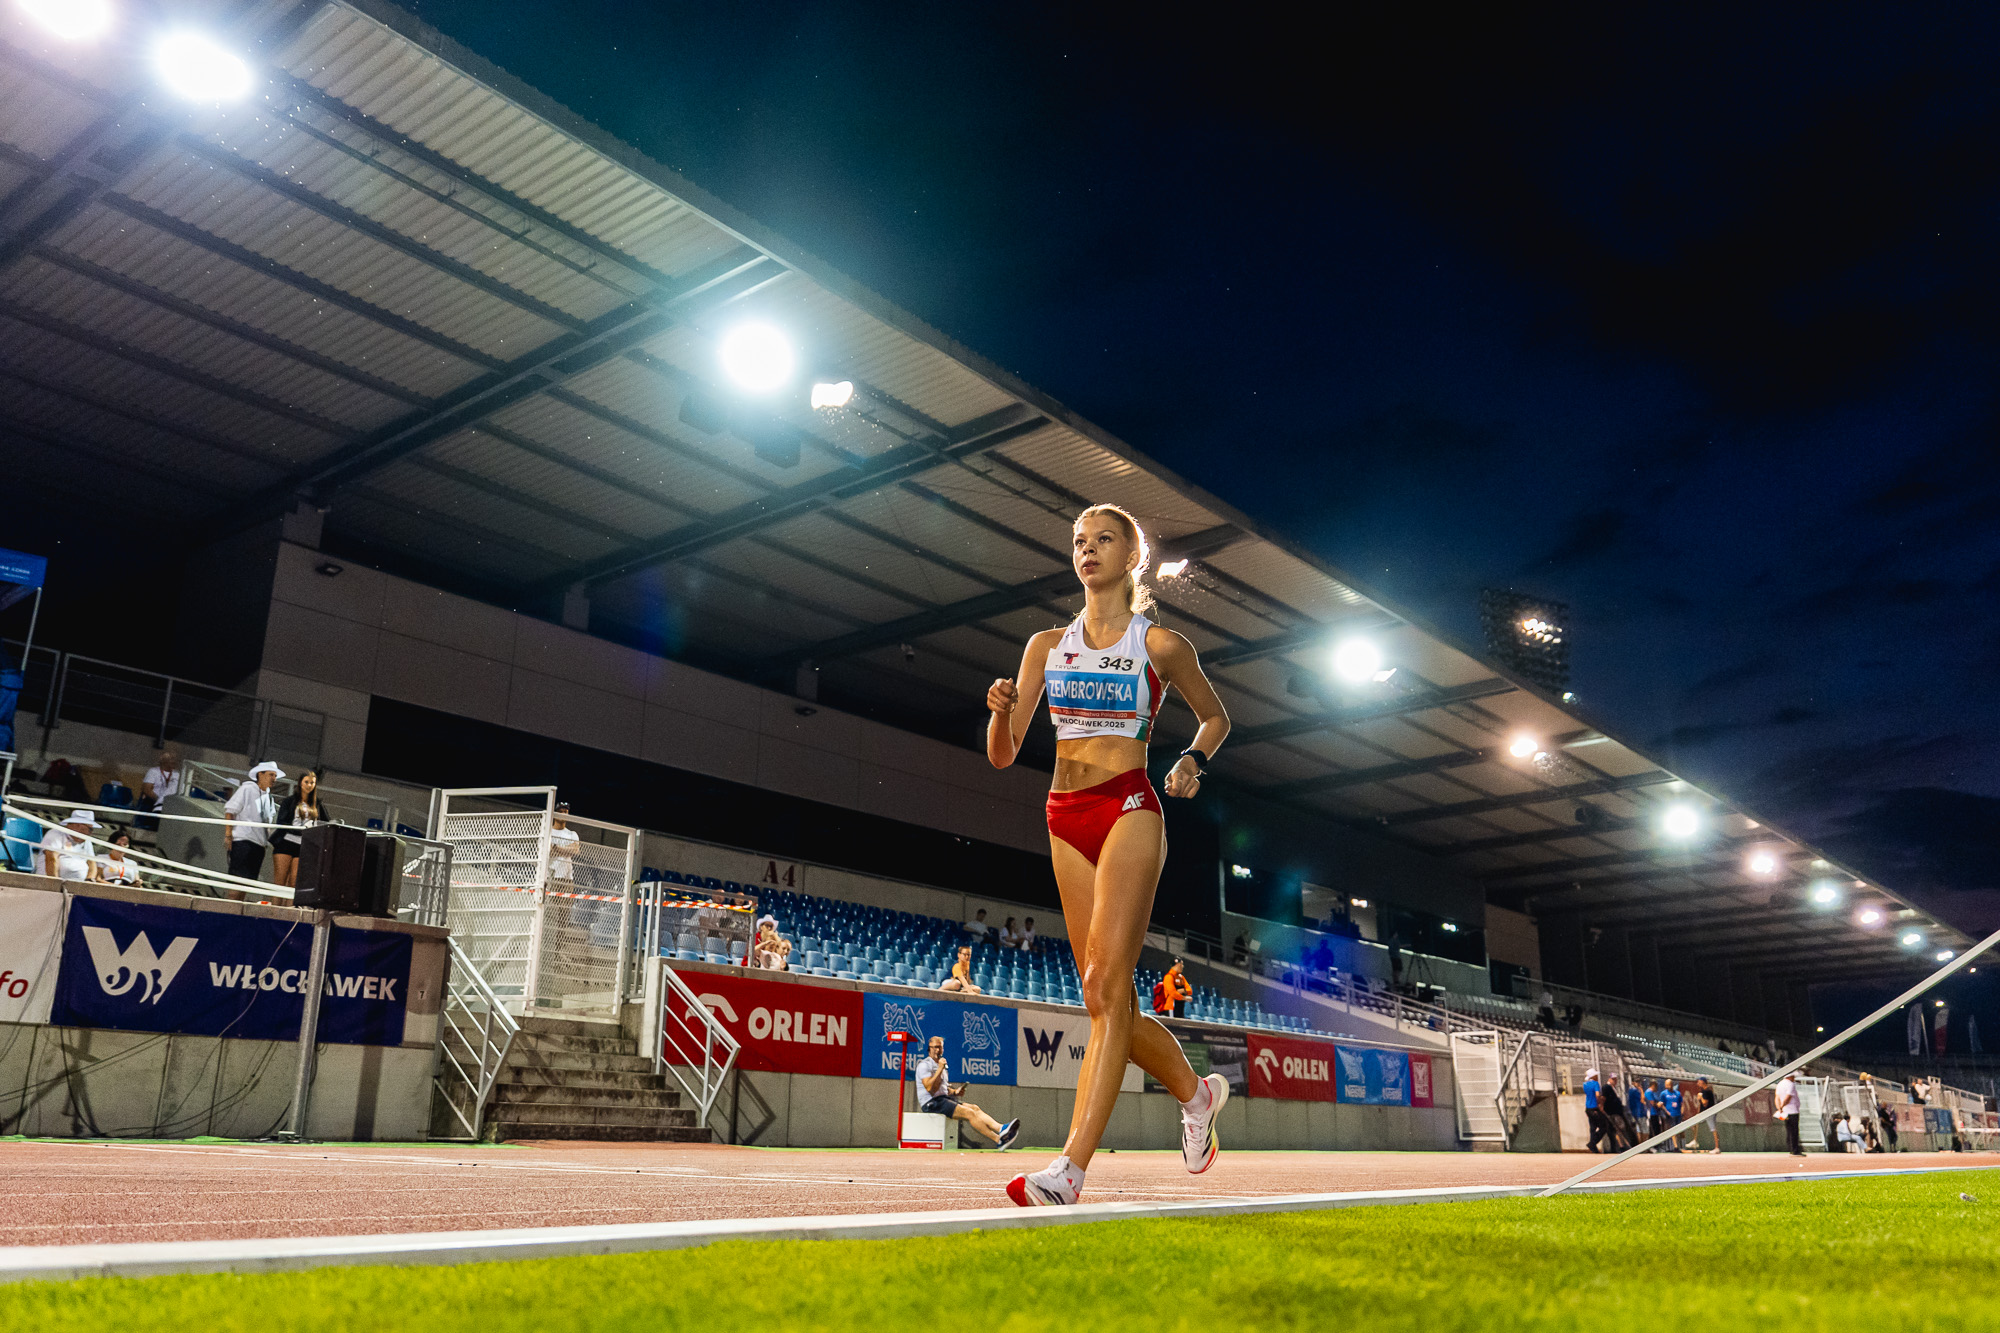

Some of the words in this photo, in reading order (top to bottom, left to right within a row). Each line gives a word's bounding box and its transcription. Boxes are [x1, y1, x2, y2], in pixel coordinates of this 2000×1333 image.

[1098, 656, 1133, 672] 343
[1048, 680, 1133, 701] ZEMBROWSKA
[1104, 720, 1126, 729] 2025
[762, 860, 797, 887] A4
[748, 1006, 848, 1047] ORLEN
[961, 1057, 1001, 1077] Nestlé
[1282, 1056, 1329, 1082] ORLEN
